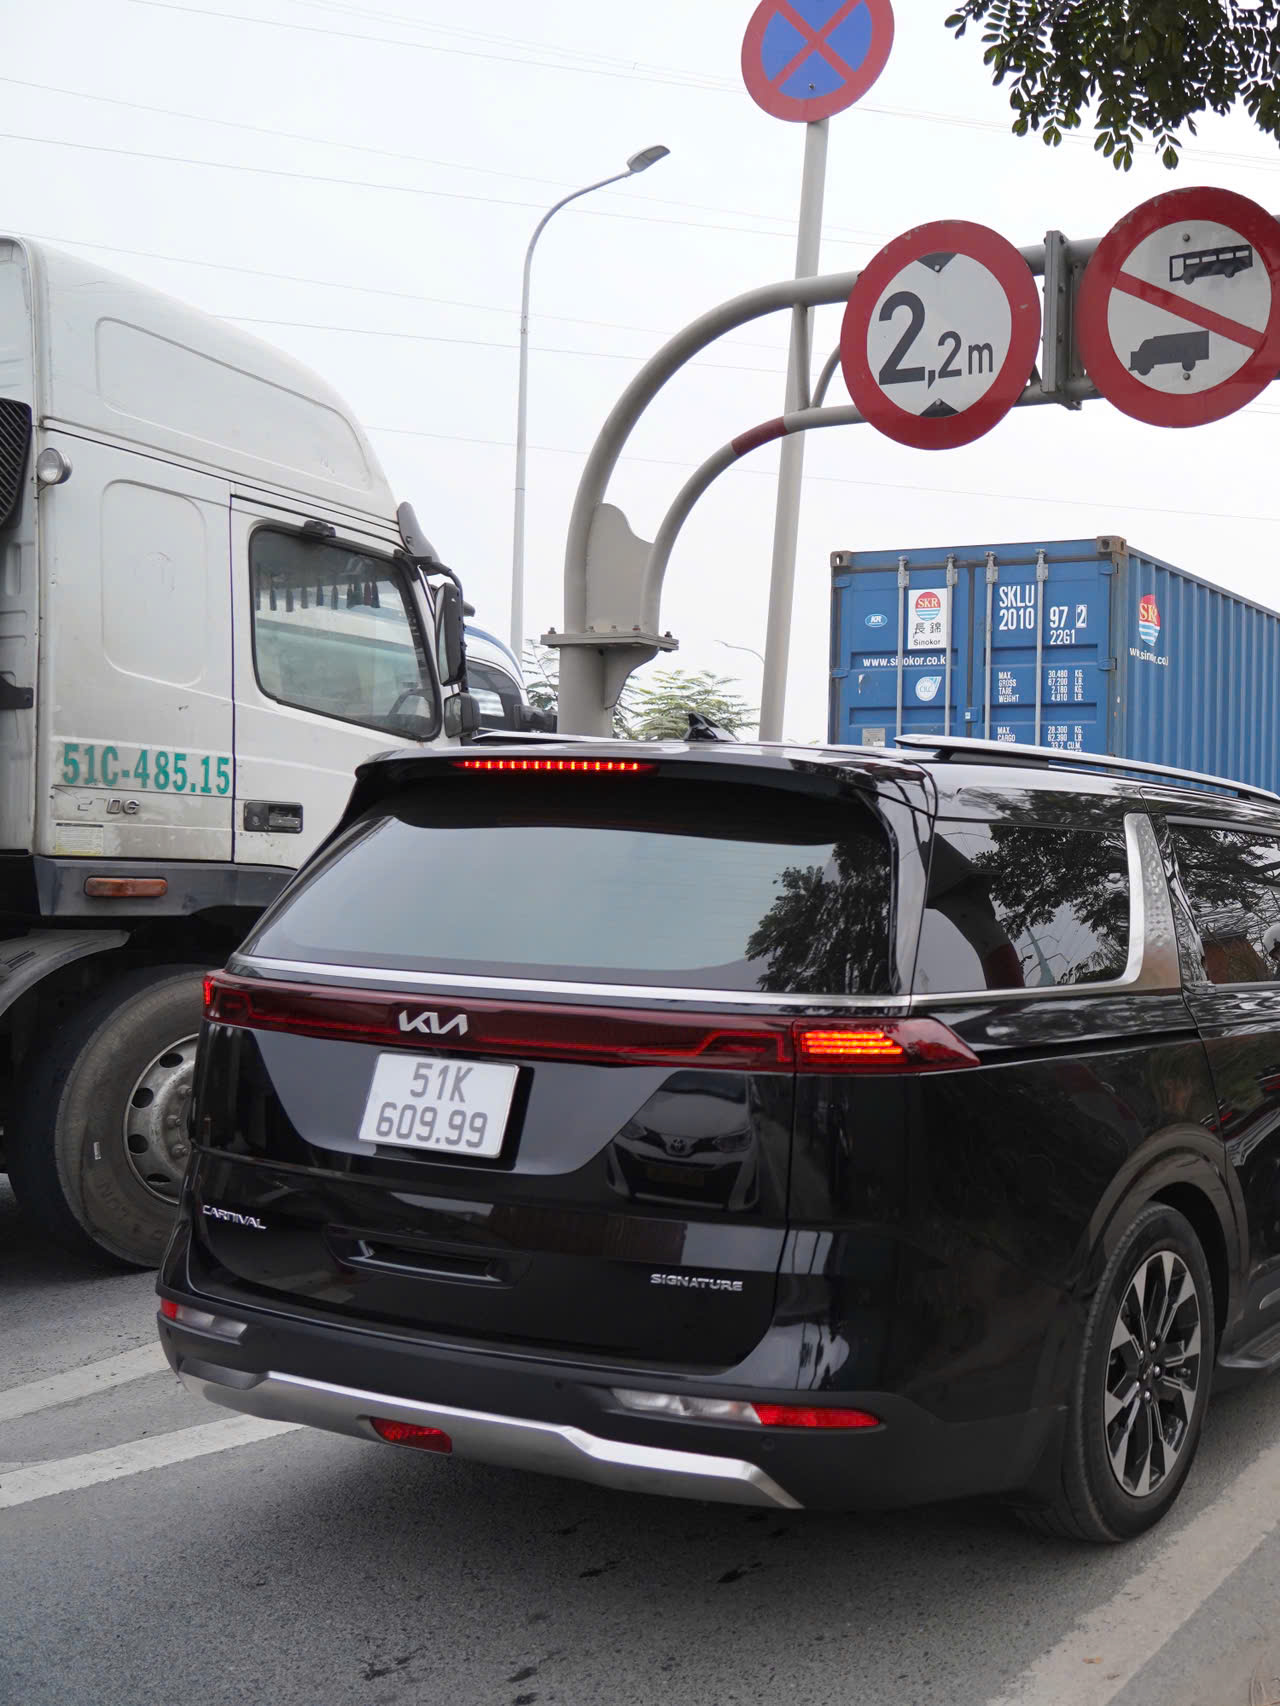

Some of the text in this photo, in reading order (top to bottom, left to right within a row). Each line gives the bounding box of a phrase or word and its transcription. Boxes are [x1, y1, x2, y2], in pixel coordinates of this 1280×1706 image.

[917, 598, 939, 608] SKR
[999, 585, 1035, 608] SKLU
[999, 605, 1087, 630] 2010 97 2
[1050, 629, 1076, 645] 22G1
[863, 655, 946, 667] www.siokor.co.k
[998, 694, 1020, 702] WEIGHT
[997, 734, 1016, 742] CARGO
[62, 742, 230, 795] 51C-485.15
[399, 1010, 469, 1036] KIA
[410, 1062, 474, 1103] 51K
[376, 1101, 488, 1148] 609.99
[650, 1273, 744, 1292] SIGNATURE
